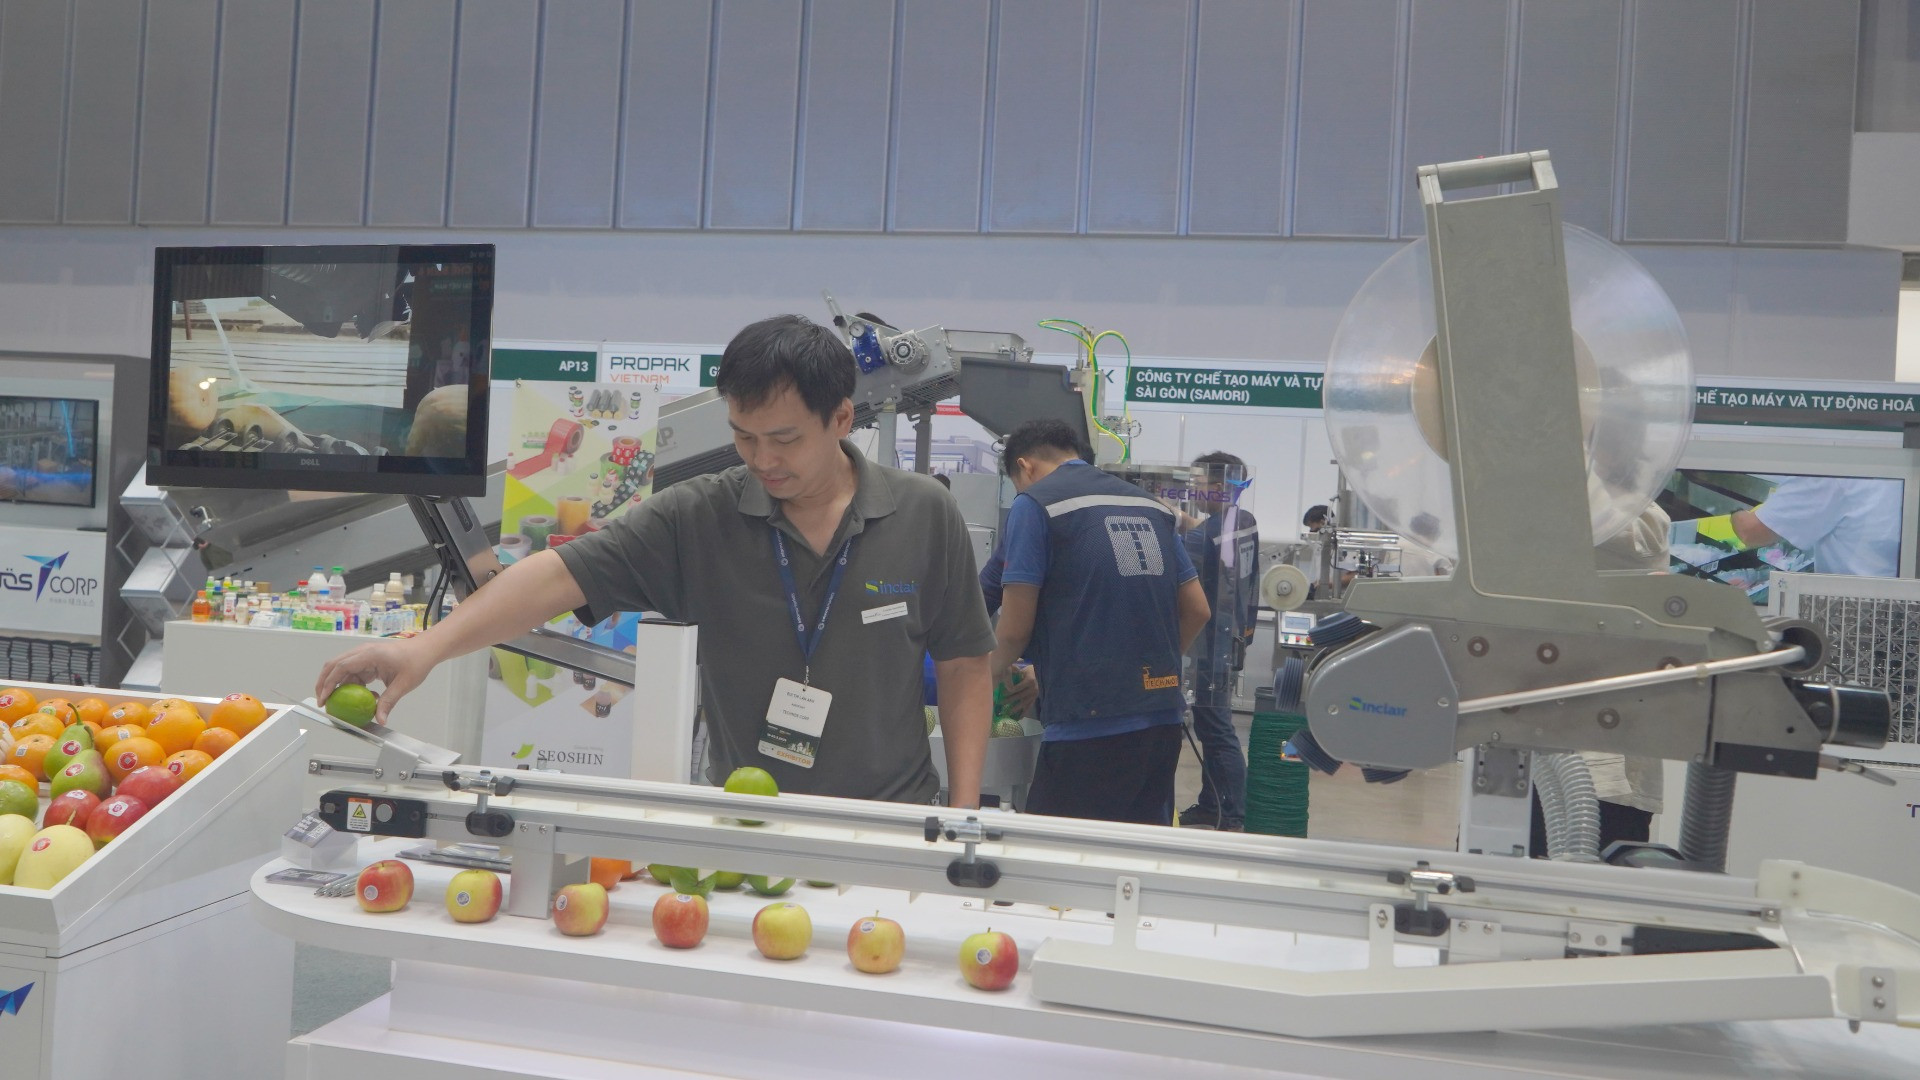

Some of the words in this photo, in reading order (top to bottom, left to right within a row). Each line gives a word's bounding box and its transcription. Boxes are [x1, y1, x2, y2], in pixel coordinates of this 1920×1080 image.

[559, 360, 588, 372] AP13
[610, 356, 690, 371] PROPAK
[709, 365, 720, 377] G
[610, 374, 669, 383] VIETNAM
[1136, 370, 1172, 384] CÔNG
[1175, 373, 1193, 384] TY
[1194, 370, 1222, 385] CHẾ
[1223, 374, 1248, 388] TẠO
[1252, 372, 1281, 387] MÁY
[1283, 373, 1301, 388] VÀ
[1303, 376, 1324, 391] TỰ
[1135, 384, 1157, 398] SÀI
[1159, 385, 1188, 400] GÒN
[1189, 388, 1250, 404] (SAMORI)
[1695, 389, 1718, 405] HẾ
[1720, 392, 1748, 408] TẠO
[1752, 391, 1785, 407] MÁY
[1790, 392, 1808, 408] VÀ
[1812, 396, 1834, 412] TỰ
[1835, 394, 1878, 412] ĐỘNG
[1883, 395, 1915, 412] HOÁ
[300, 458, 320, 466] DELL
[50, 576, 98, 596] CORP
[1348, 696, 1408, 717] Sinclair
[538, 749, 604, 766] SEOSHIN
[776, 750, 812, 766] EXHIBITOR
